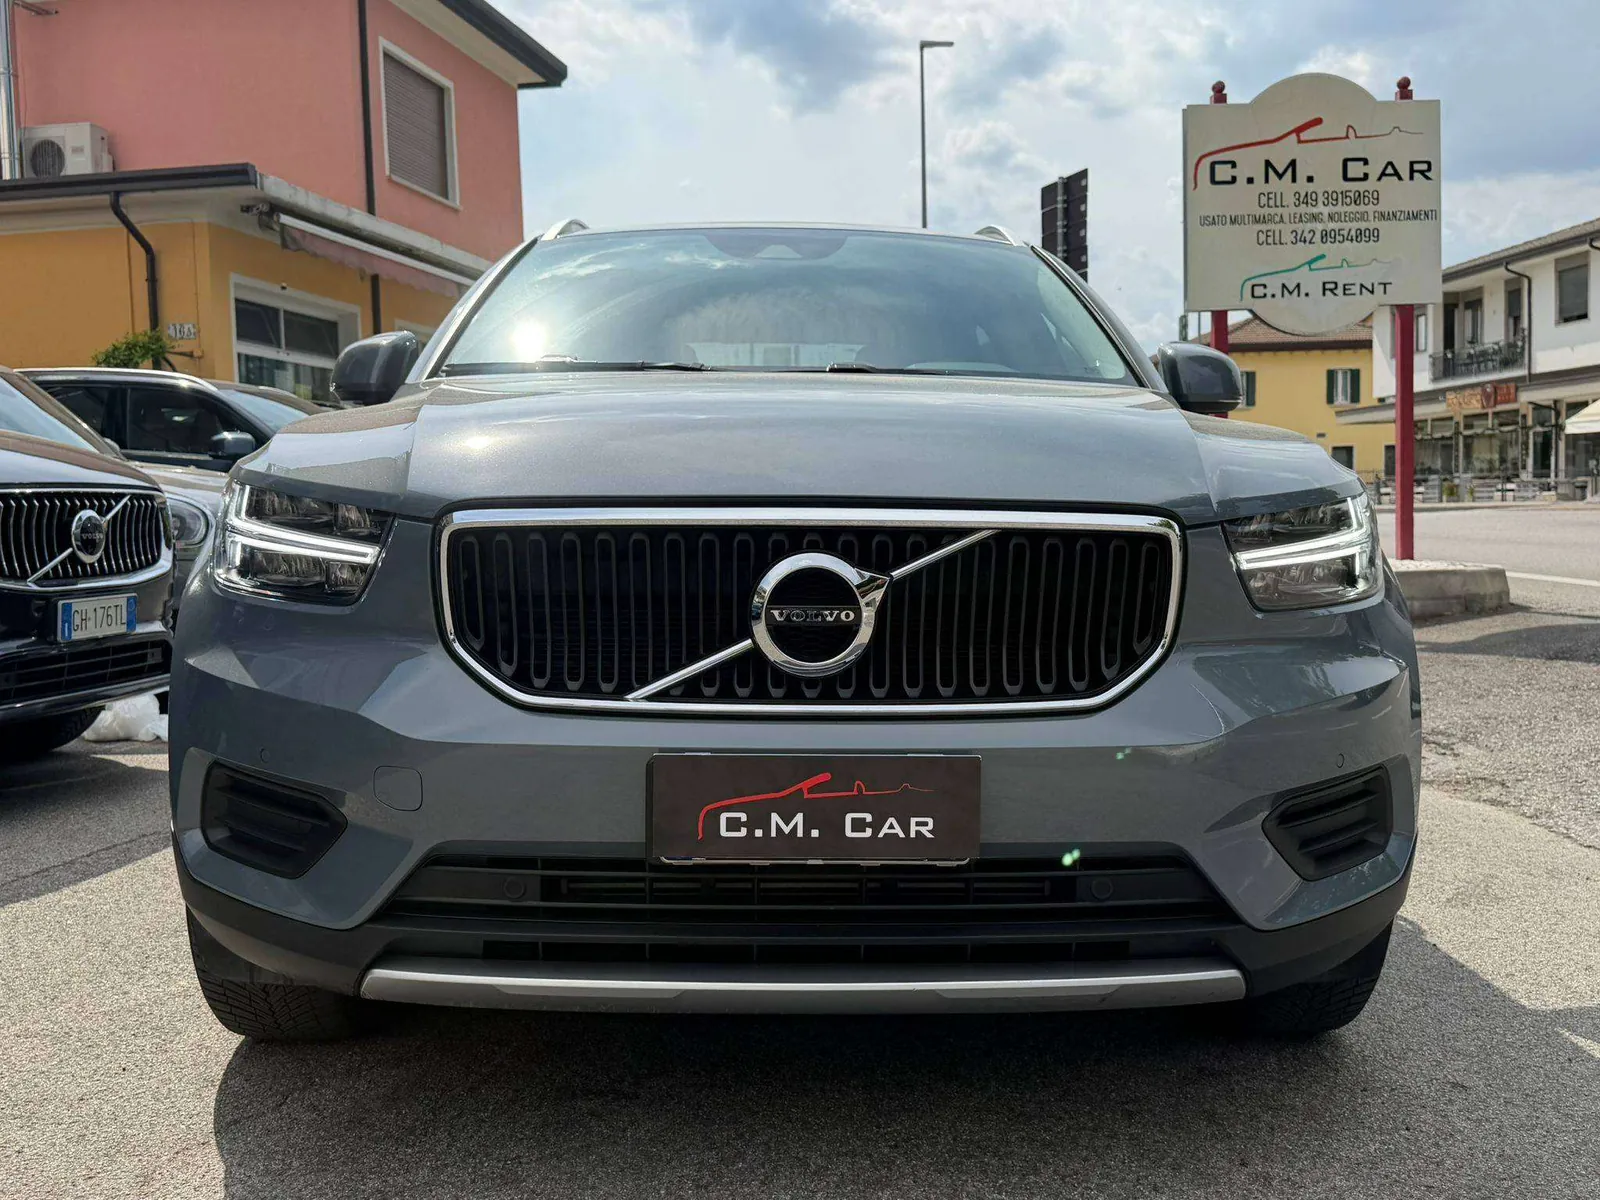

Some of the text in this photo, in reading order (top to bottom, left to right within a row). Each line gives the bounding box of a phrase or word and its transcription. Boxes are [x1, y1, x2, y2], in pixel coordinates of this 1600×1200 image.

[1209, 158, 1315, 185] C.M.
[1257, 189, 1380, 209] CELL. 349 3915069
[1199, 214, 1227, 227] USATO
[1373, 209, 1437, 222] FINANZIAMENTI
[1256, 227, 1380, 246] CELL. 342 0954099
[1250, 282, 1310, 299] C.M.
[770, 609, 856, 622] VOLVO
[719, 812, 820, 838] C.M.
